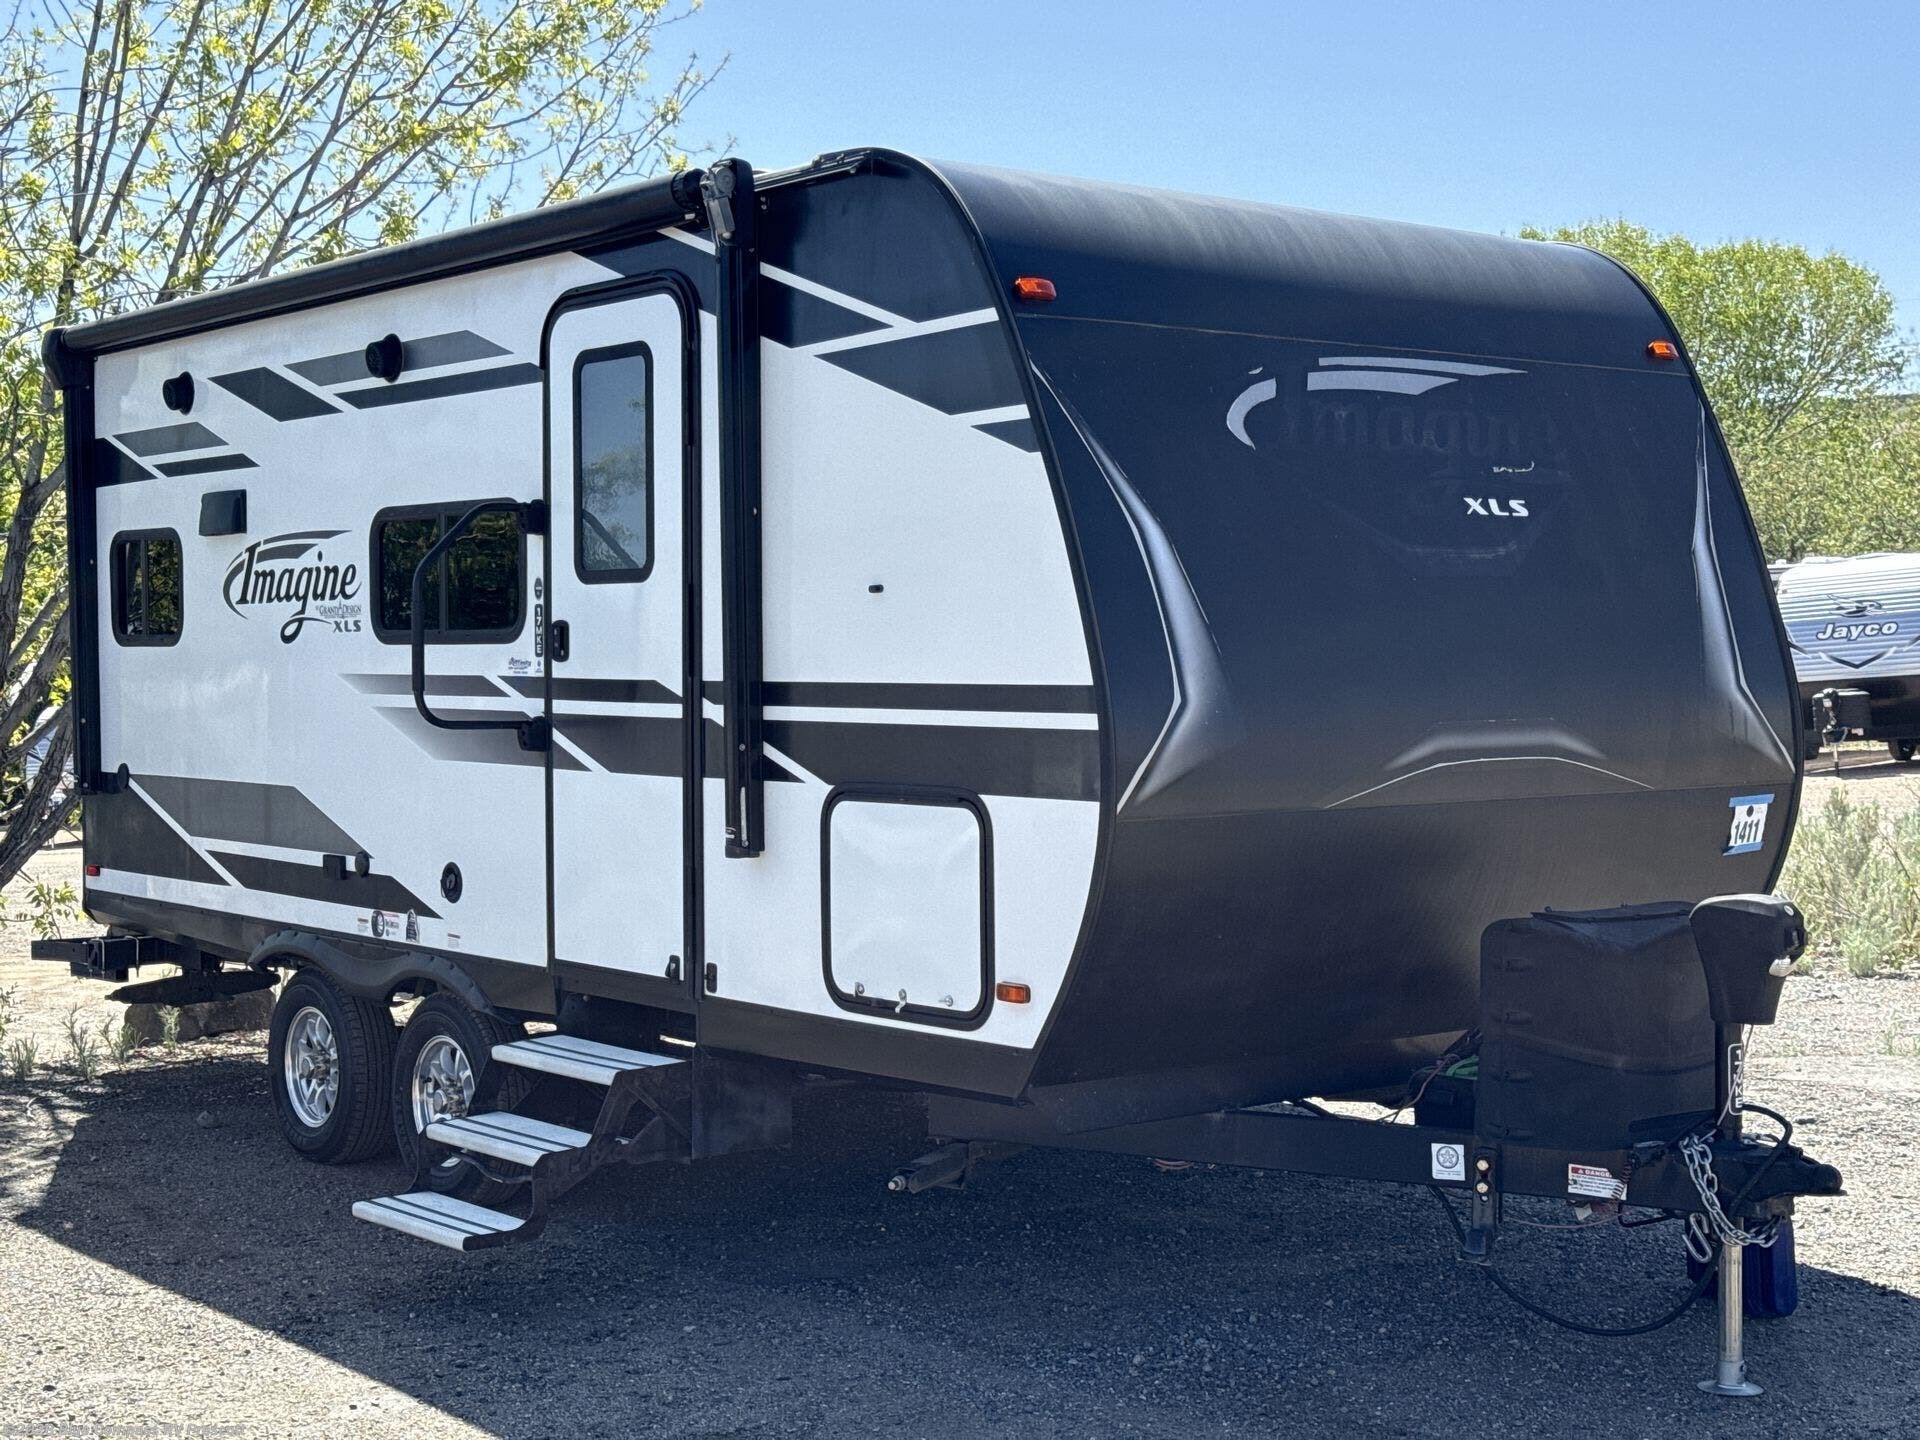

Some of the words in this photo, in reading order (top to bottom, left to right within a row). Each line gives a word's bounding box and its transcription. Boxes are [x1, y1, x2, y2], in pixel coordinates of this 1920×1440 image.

[1463, 497, 1529, 517] XLS
[235, 541, 362, 644] Imagine
[333, 619, 362, 633] XLS
[1815, 621, 1899, 641] Jayco
[1734, 818, 1761, 845] 1411
[1584, 1169, 1613, 1178] DANGE
